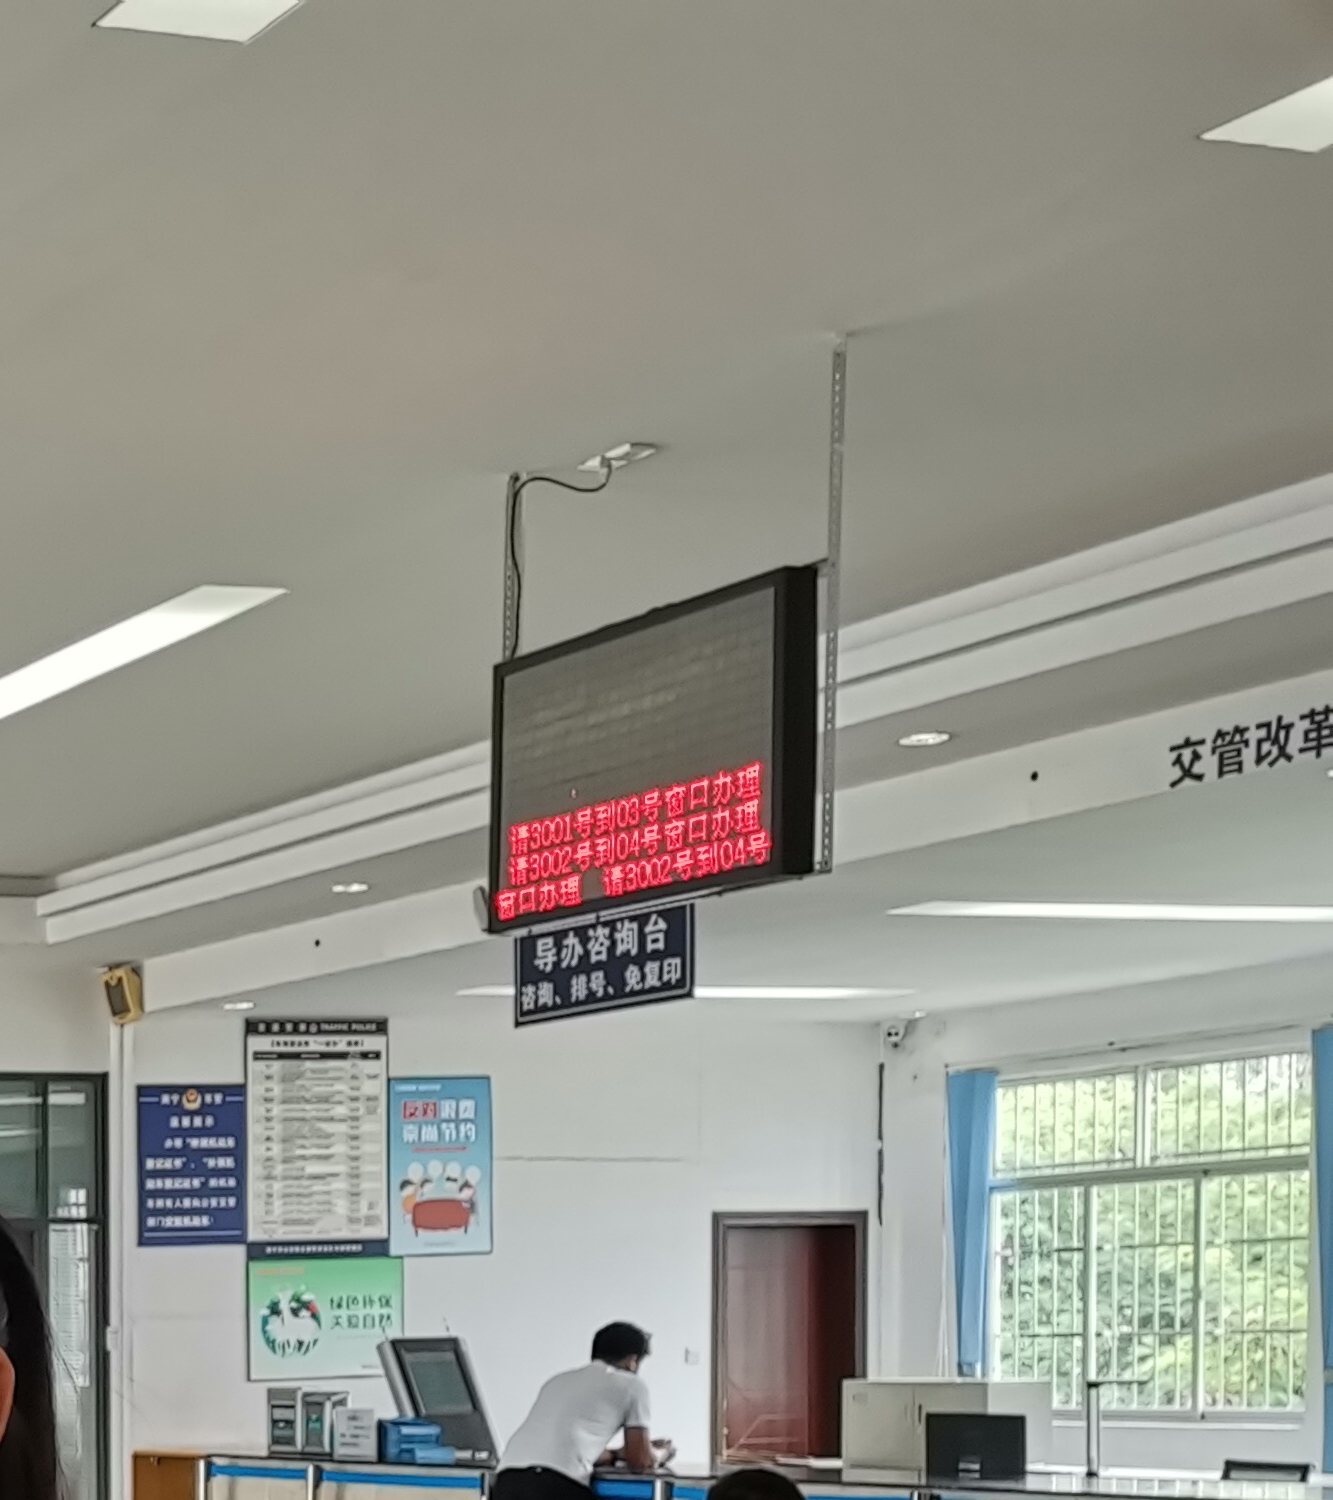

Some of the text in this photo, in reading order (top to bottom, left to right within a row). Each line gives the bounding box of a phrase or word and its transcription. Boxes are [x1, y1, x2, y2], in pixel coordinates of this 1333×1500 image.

[1169, 704, 1333, 788] 交管改革
[507, 798, 760, 886] 请3002号到04号窗口办理
[508, 761, 763, 855] 请3001号到03号窗口办理
[495, 831, 772, 921] 窗口办理 请3002号到04号
[521, 957, 682, 1011] 咨询、排号、免复印
[533, 914, 667, 973] 导办咨询台
